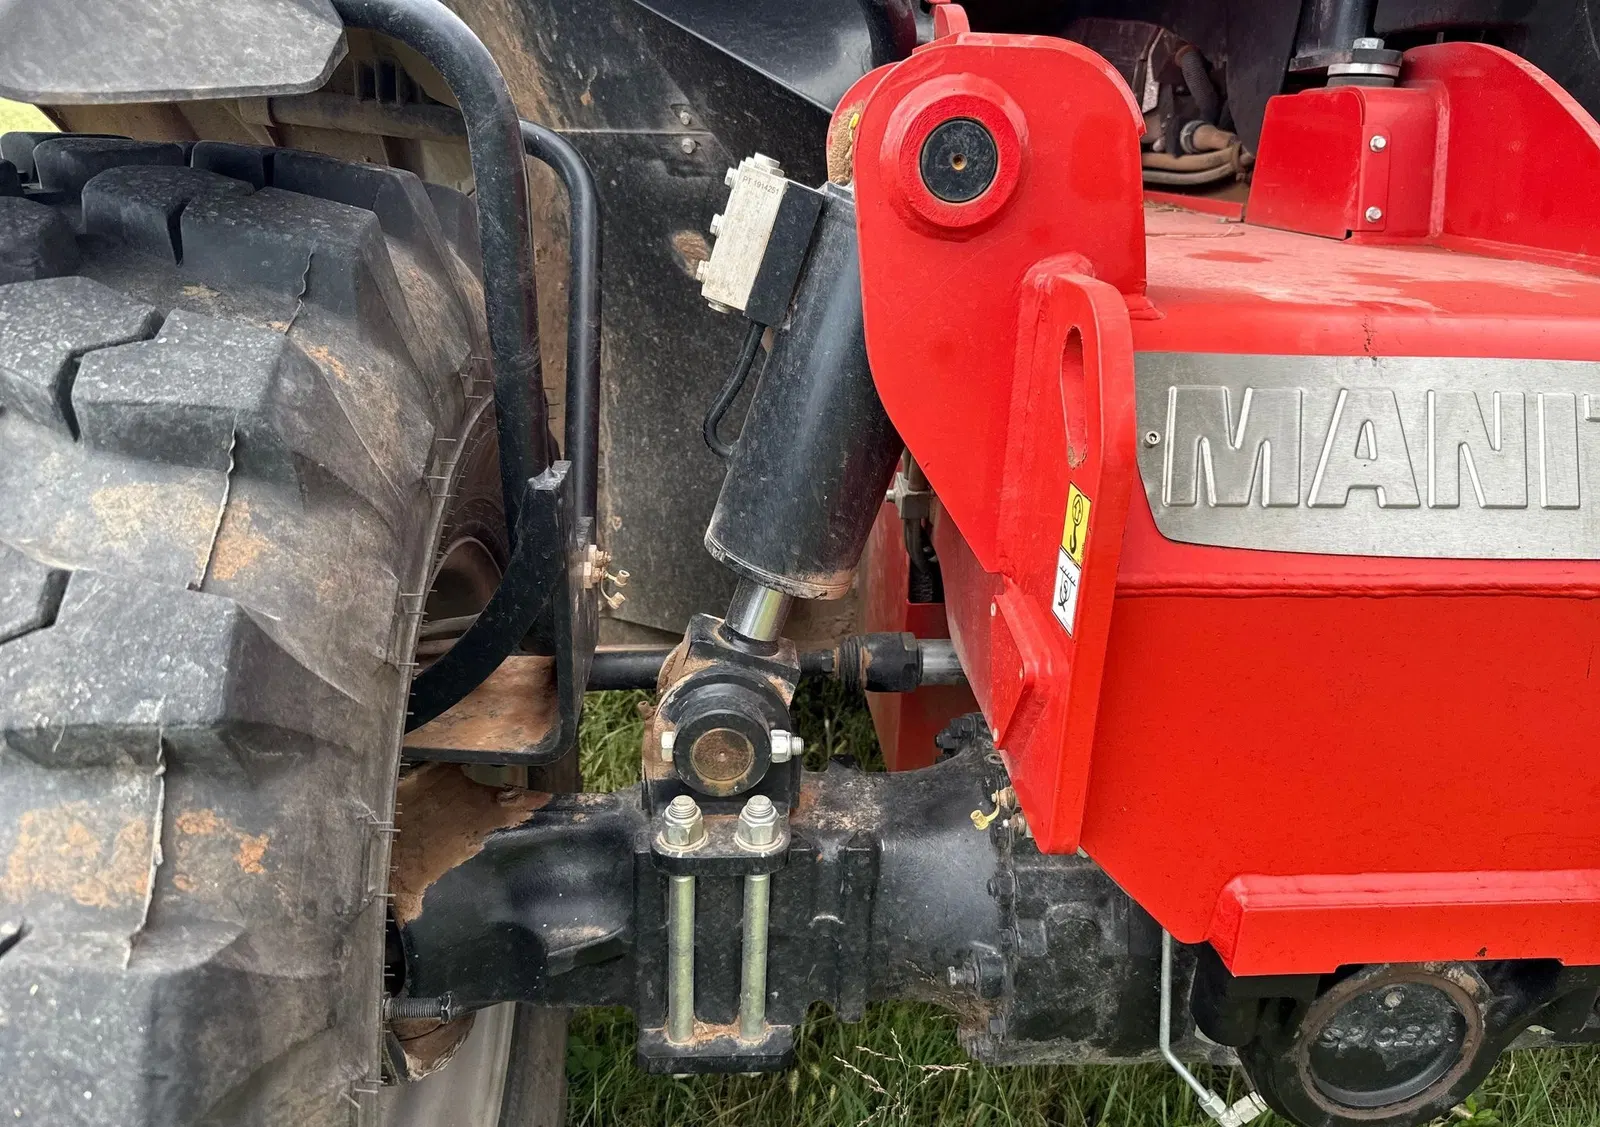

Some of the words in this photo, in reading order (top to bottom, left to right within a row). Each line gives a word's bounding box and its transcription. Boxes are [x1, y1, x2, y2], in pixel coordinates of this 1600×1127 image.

[742, 175, 752, 185] PT
[754, 180, 779, 195] 1914251
[1162, 385, 1600, 509] MANI
